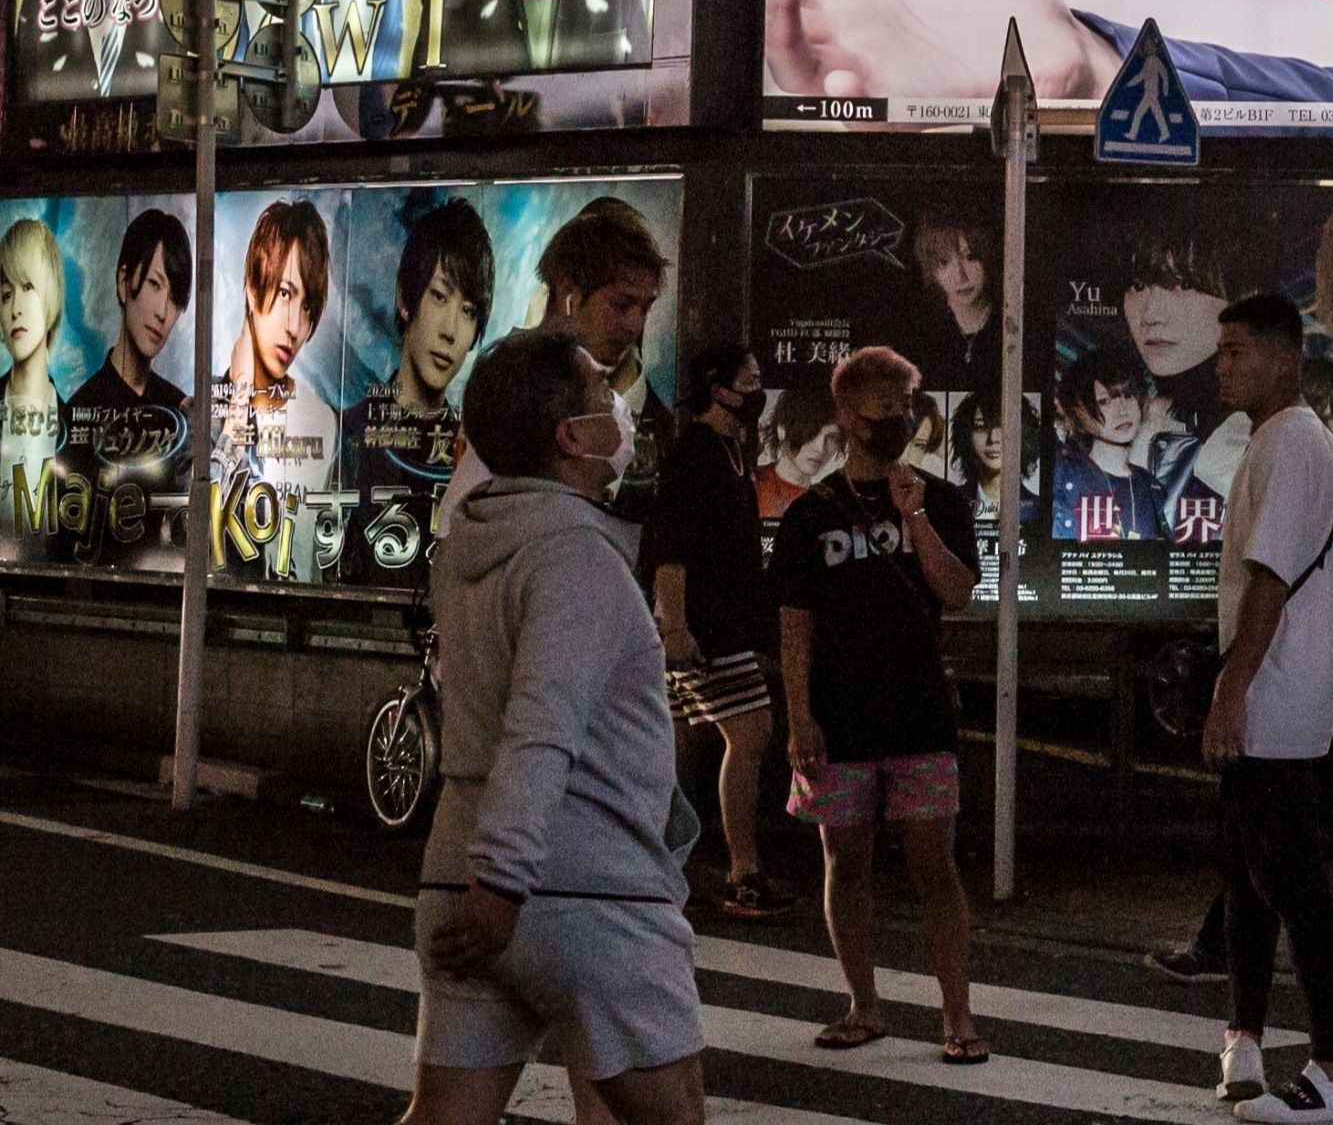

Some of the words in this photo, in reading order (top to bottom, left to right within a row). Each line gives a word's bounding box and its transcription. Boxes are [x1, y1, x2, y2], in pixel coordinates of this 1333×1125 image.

[818, 99, 874, 120] 100m
[1288, 109, 1316, 123] TEL
[1068, 281, 1101, 303] Yu
